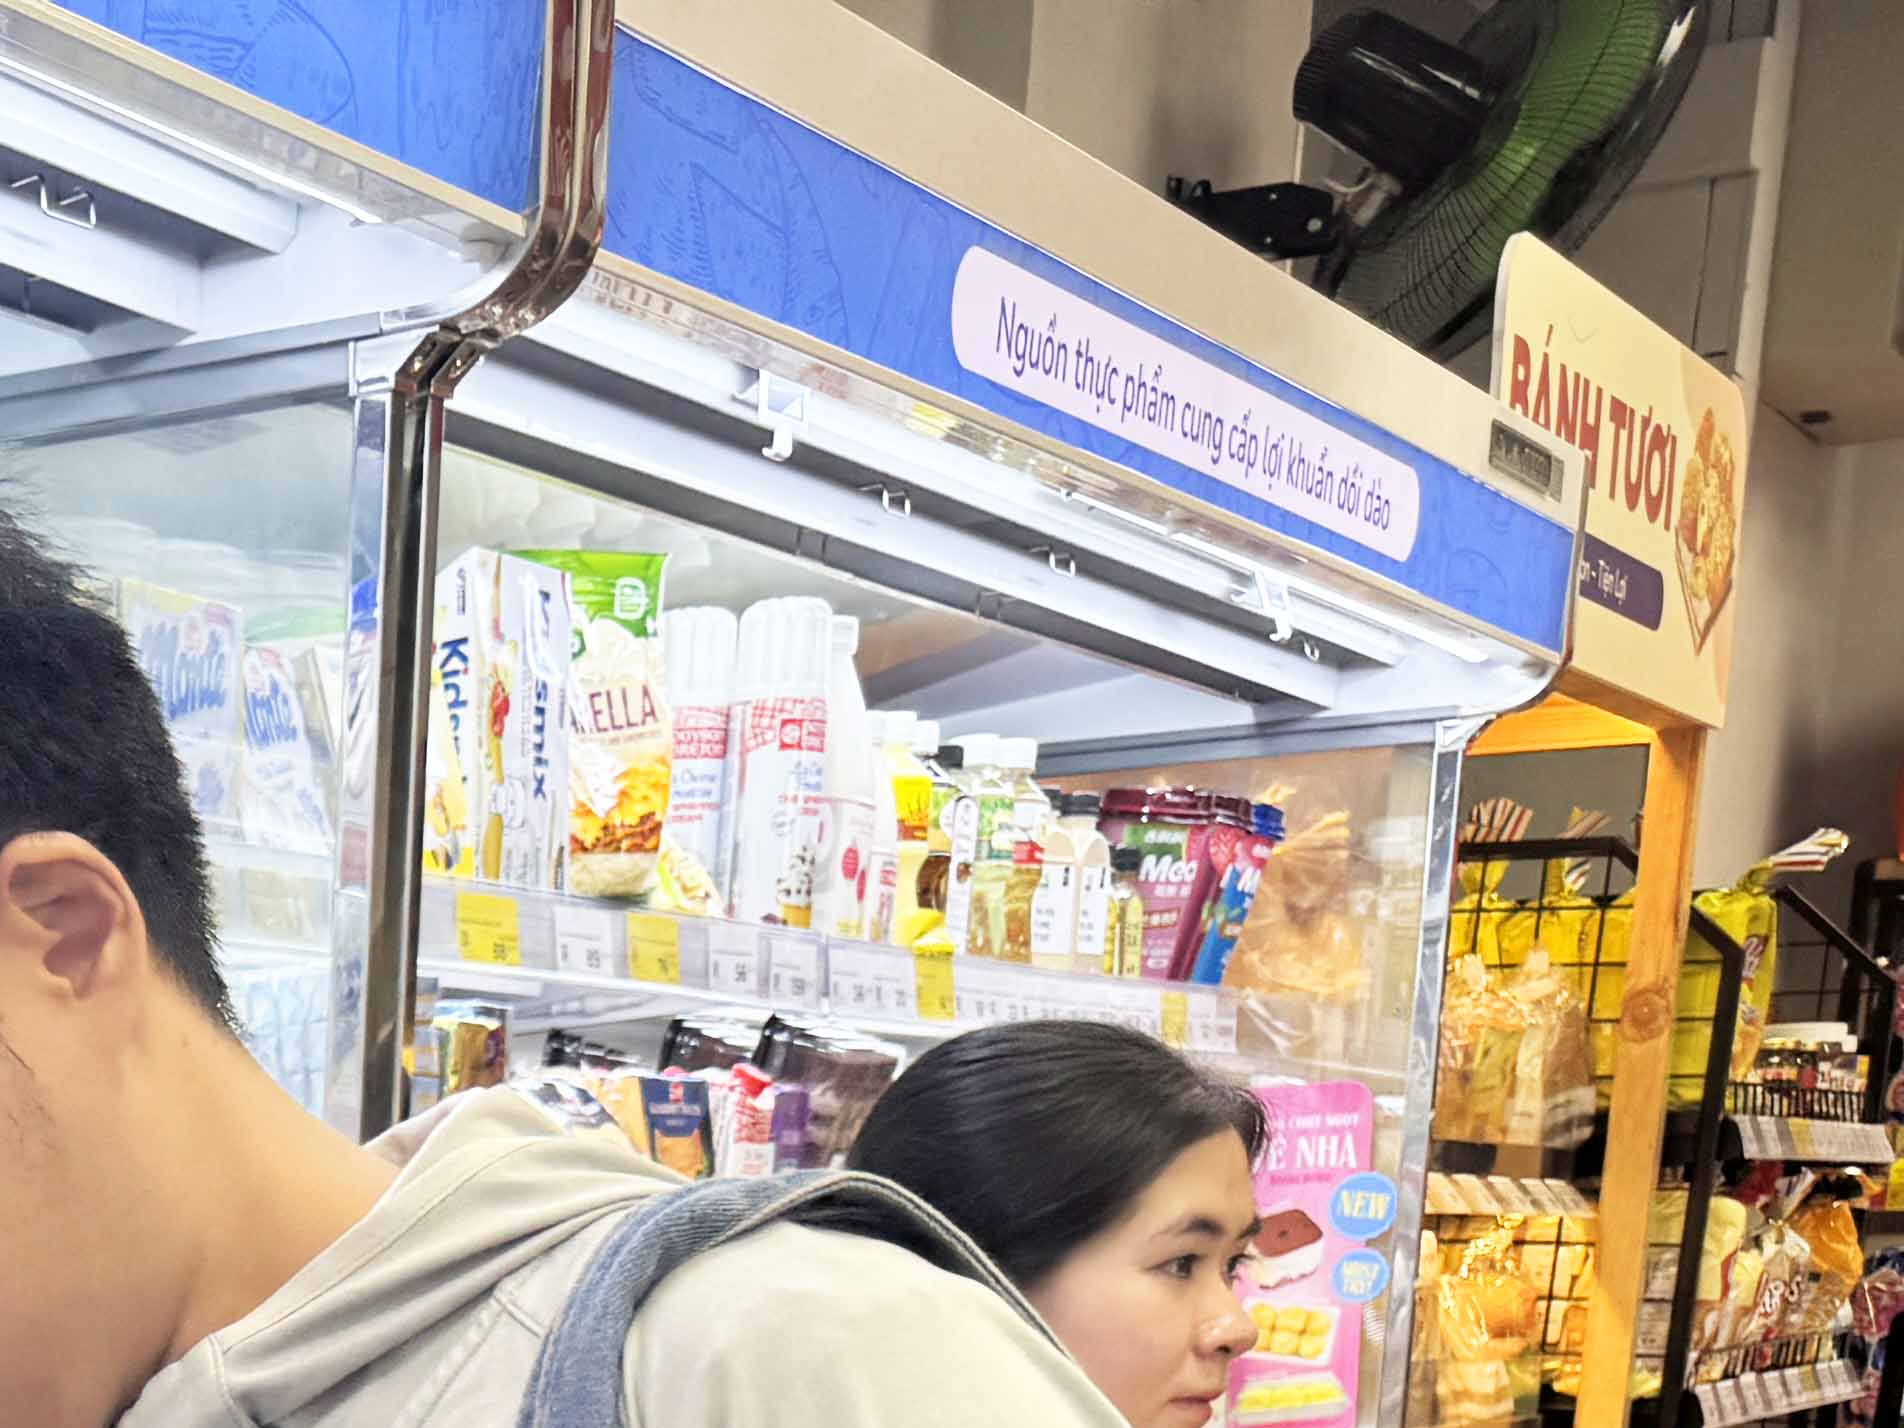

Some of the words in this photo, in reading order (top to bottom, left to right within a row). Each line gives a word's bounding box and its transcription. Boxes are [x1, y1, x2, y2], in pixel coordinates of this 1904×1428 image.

[995, 296, 1068, 380] Nguồn
[1073, 340, 1119, 413] thực
[1122, 362, 1176, 433] phẩm
[1180, 403, 1224, 465] cung
[1227, 409, 1259, 474] cấp
[1262, 428, 1284, 492] lợi
[1287, 444, 1334, 501] khuẩn
[1509, 323, 1604, 490] BÁNH
[1608, 394, 1678, 532] TƯƠI
[1335, 1190, 1390, 1220] NEW
